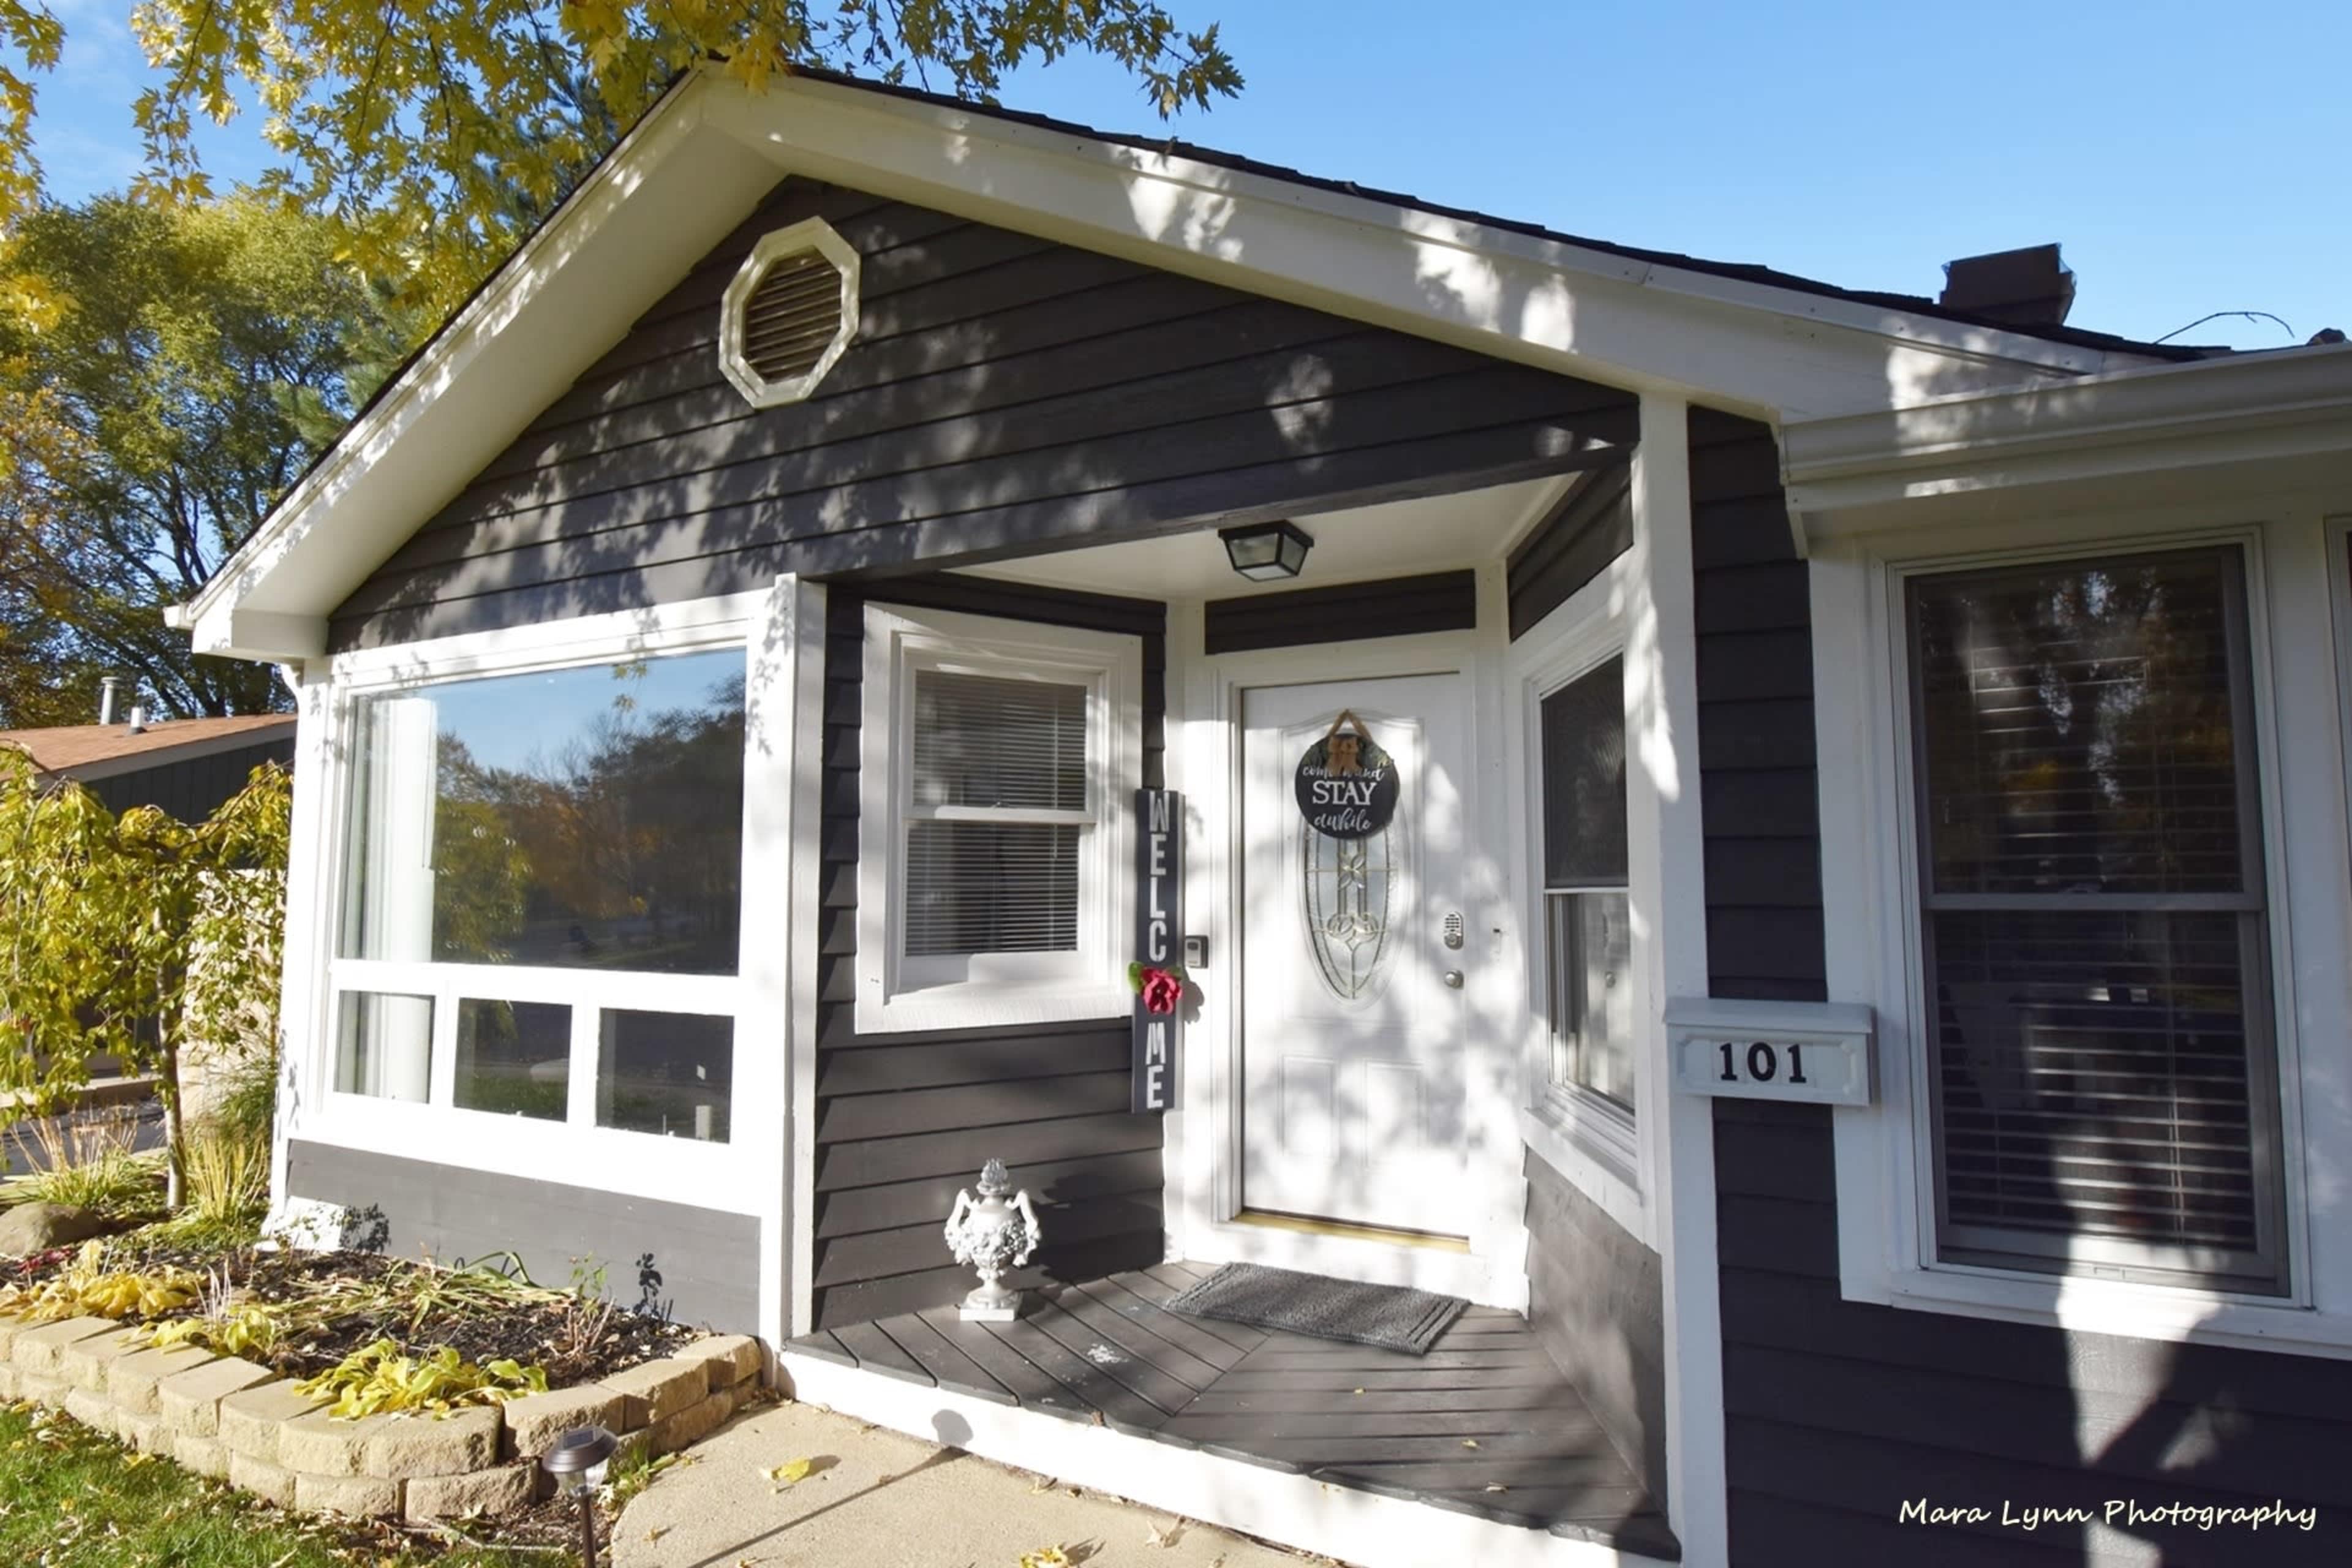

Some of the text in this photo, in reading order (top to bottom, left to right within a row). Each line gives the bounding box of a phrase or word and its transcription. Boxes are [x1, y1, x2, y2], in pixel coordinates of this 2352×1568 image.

[1313, 780, 1378, 805] STAY
[1146, 790, 1170, 1109] WELCME
[1719, 1042, 1807, 1084] 101
